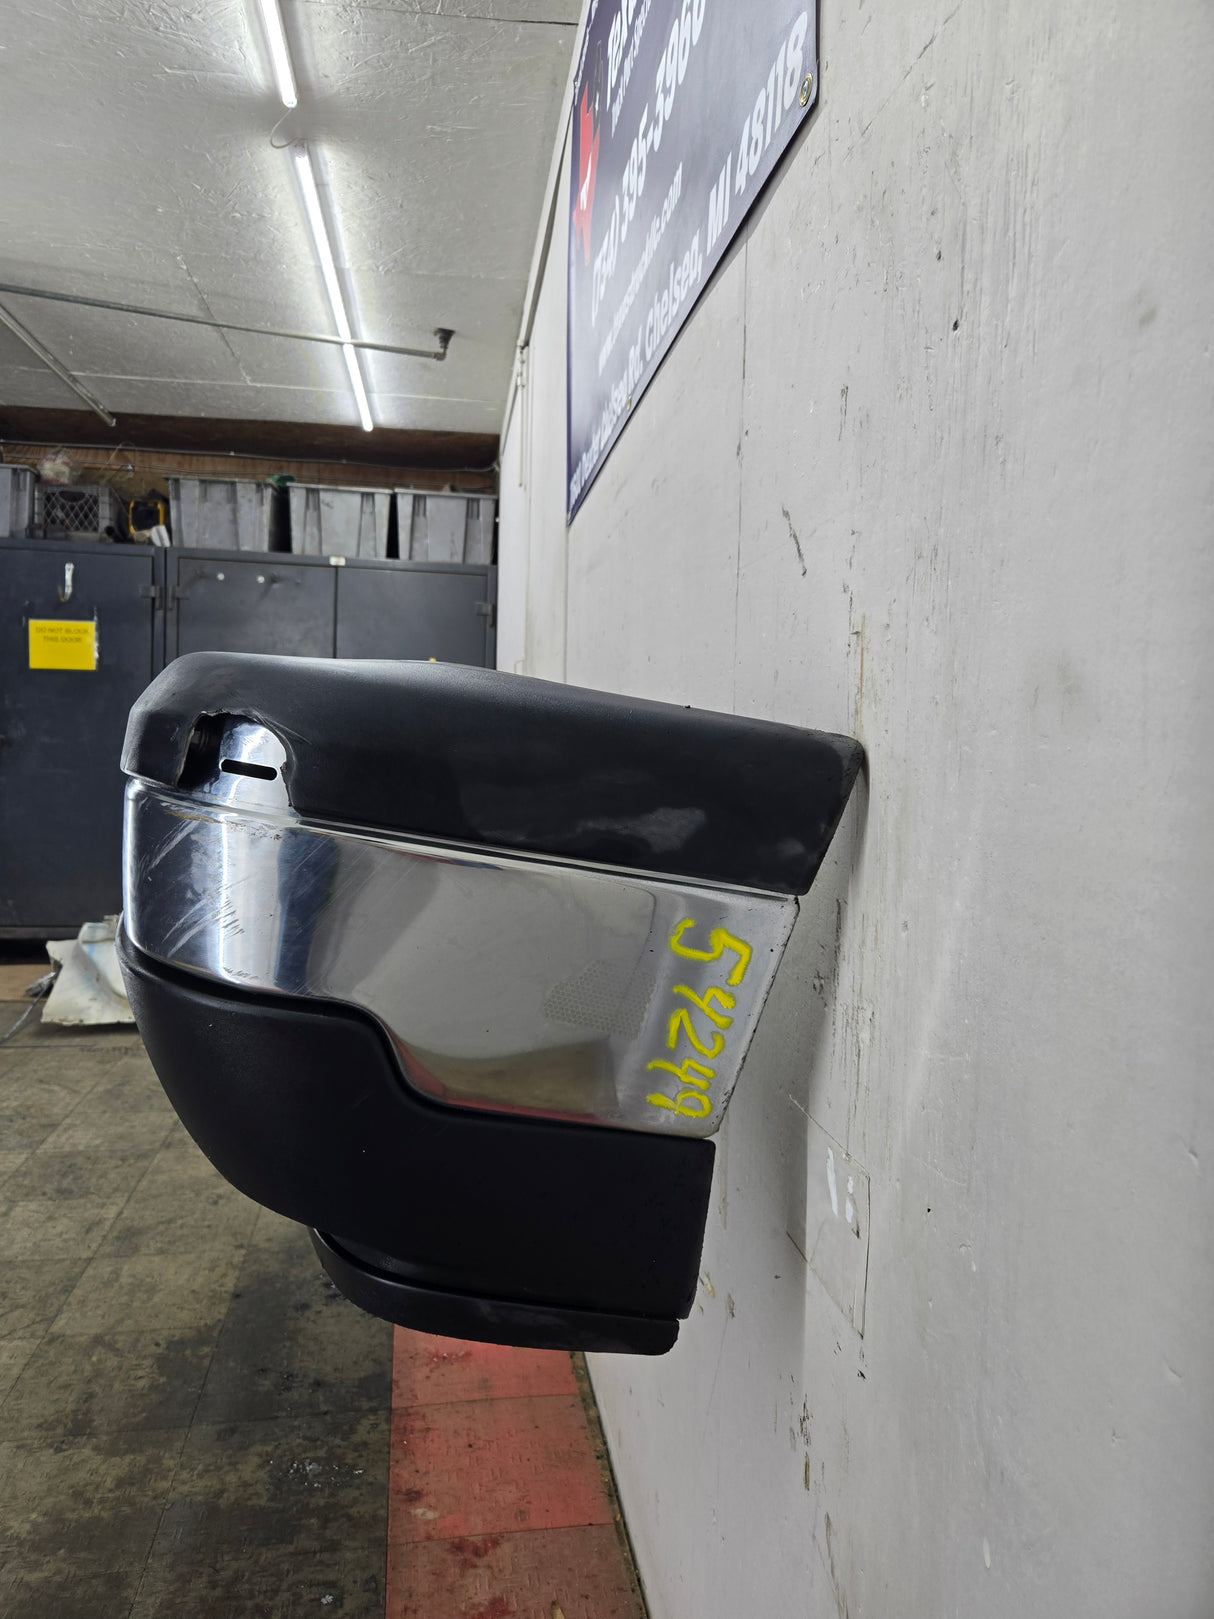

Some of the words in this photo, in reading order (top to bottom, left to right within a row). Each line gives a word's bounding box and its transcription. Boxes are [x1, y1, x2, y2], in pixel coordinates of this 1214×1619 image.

[628, 325, 643, 395] Rd.
[645, 229, 703, 361] Chelsea,
[707, 152, 732, 256] MI
[735, 11, 808, 196] 48118
[646, 916, 753, 1118] 54249
